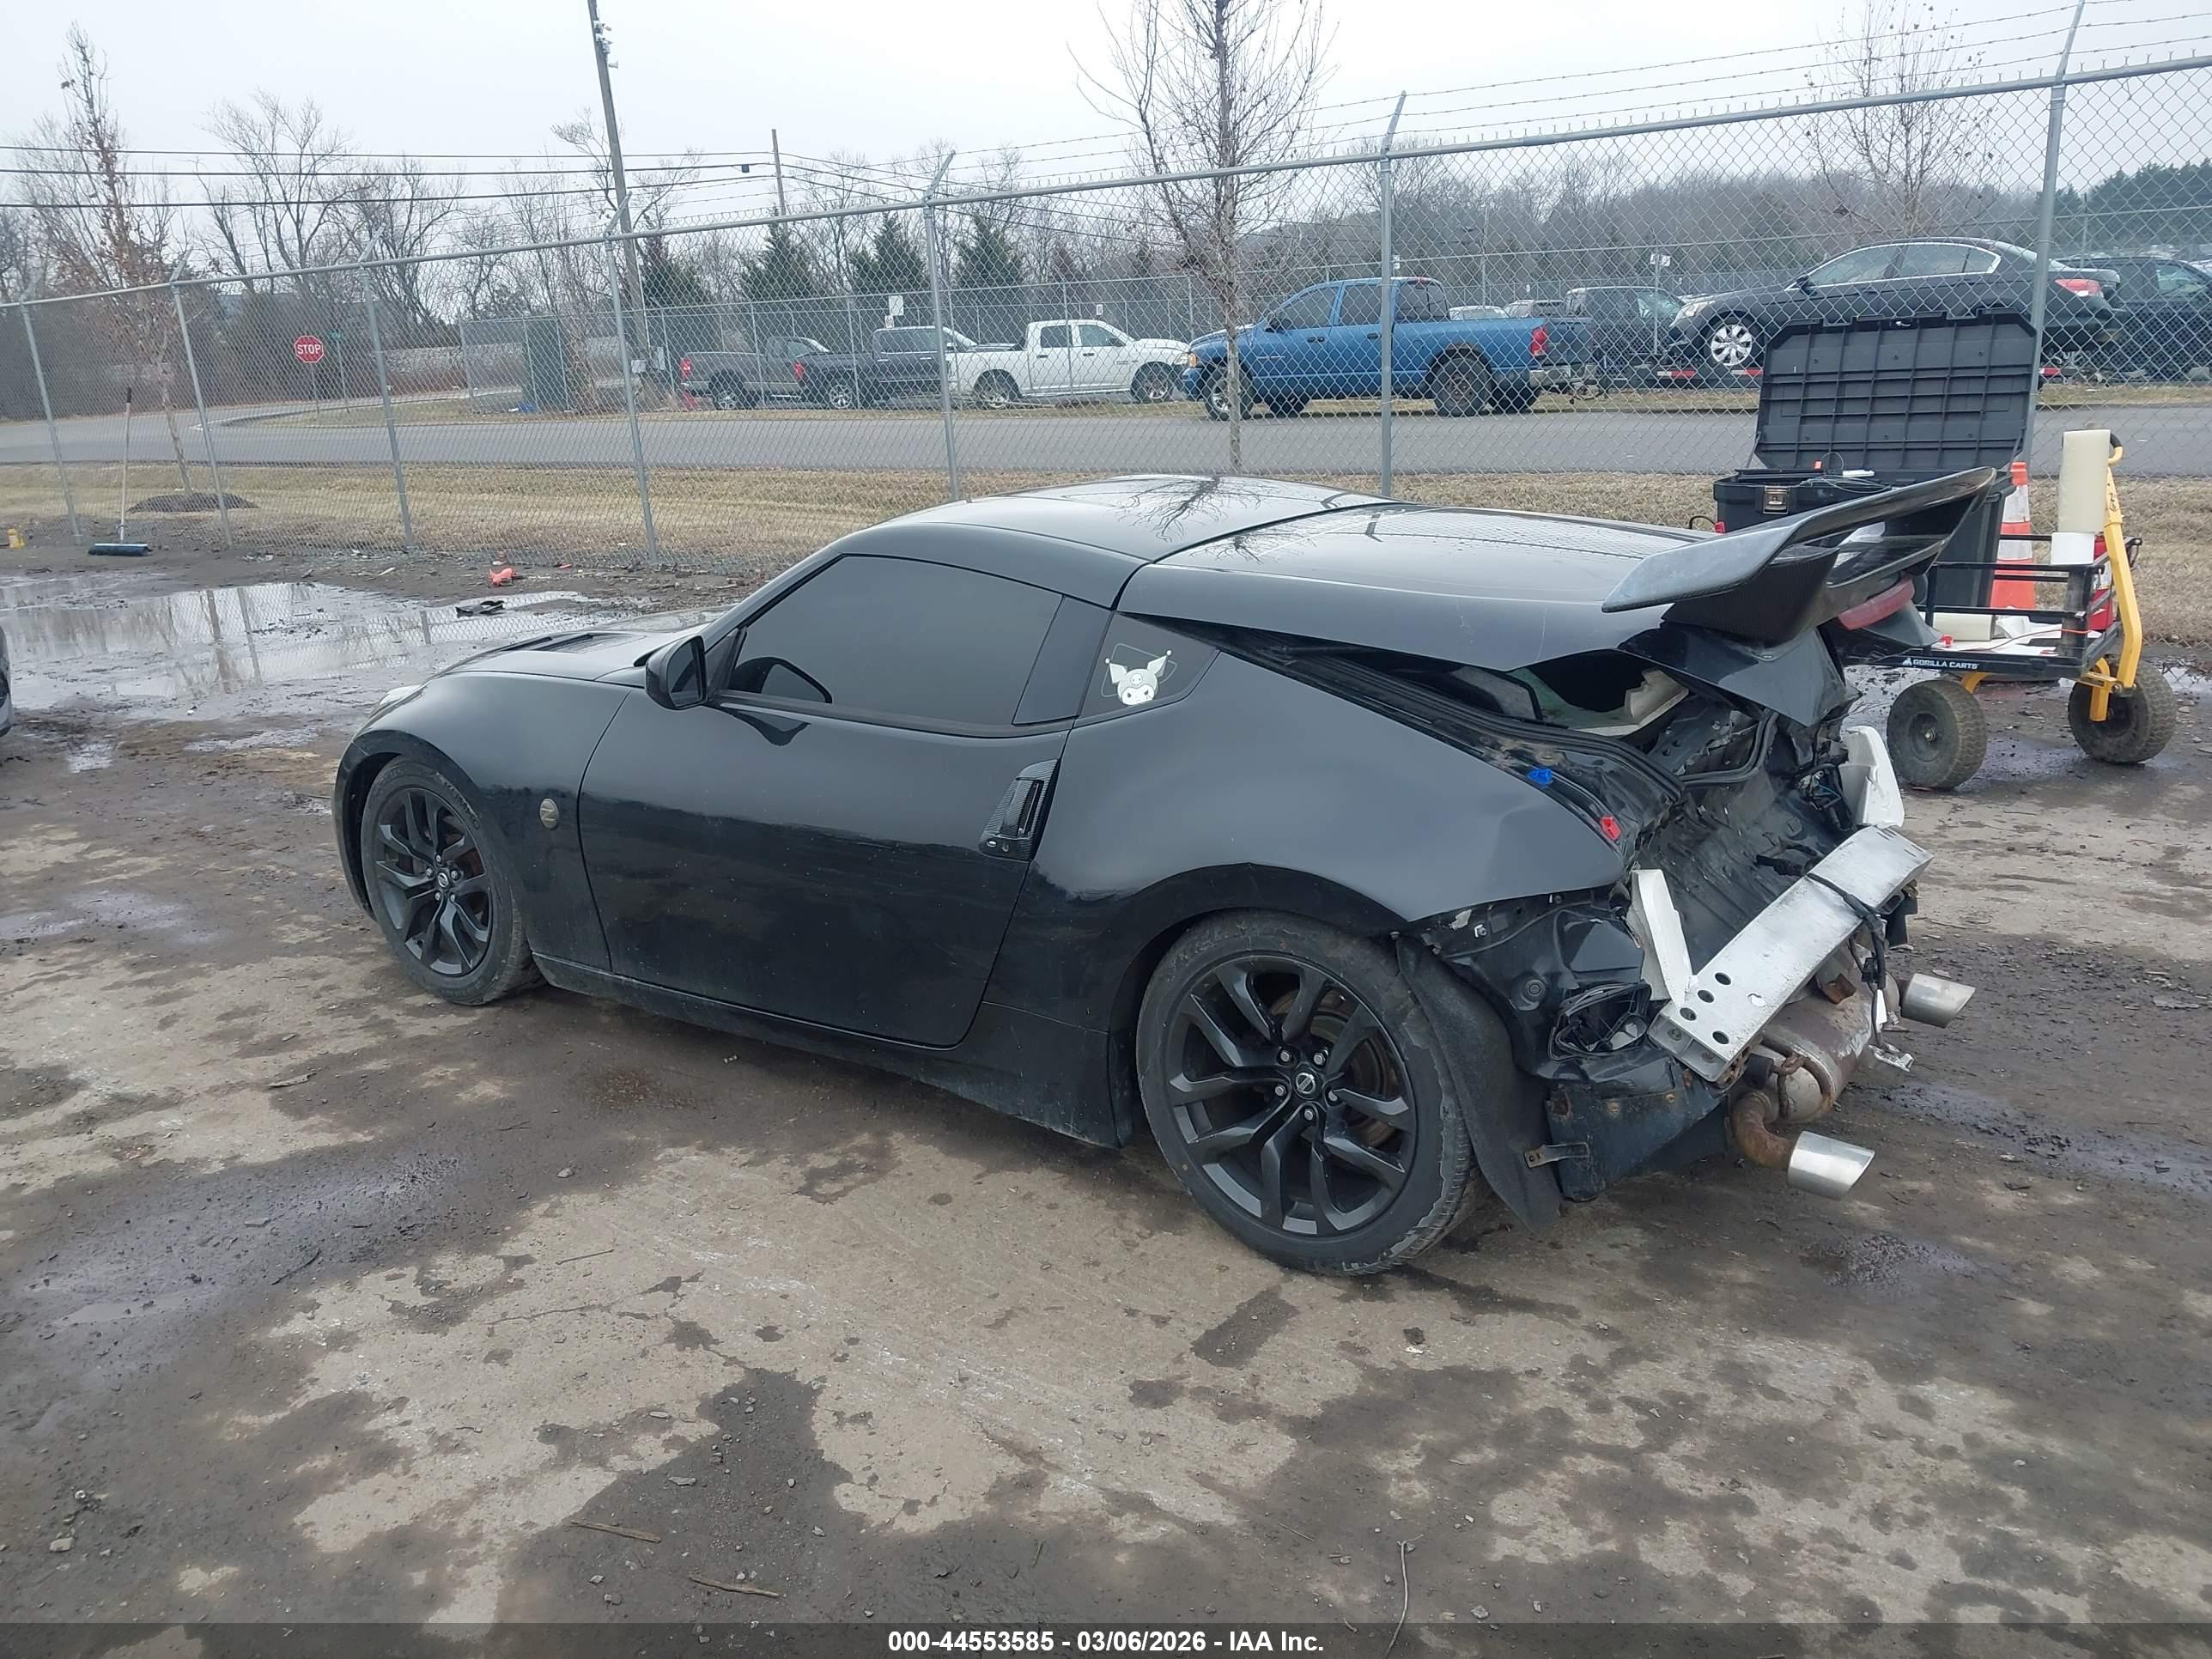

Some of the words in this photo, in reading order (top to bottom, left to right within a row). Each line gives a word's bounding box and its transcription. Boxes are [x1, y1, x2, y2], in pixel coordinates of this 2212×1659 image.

[297, 344, 321, 355] STOP
[1912, 659, 1948, 667] GORILLA
[1949, 661, 1978, 670] CARTS
